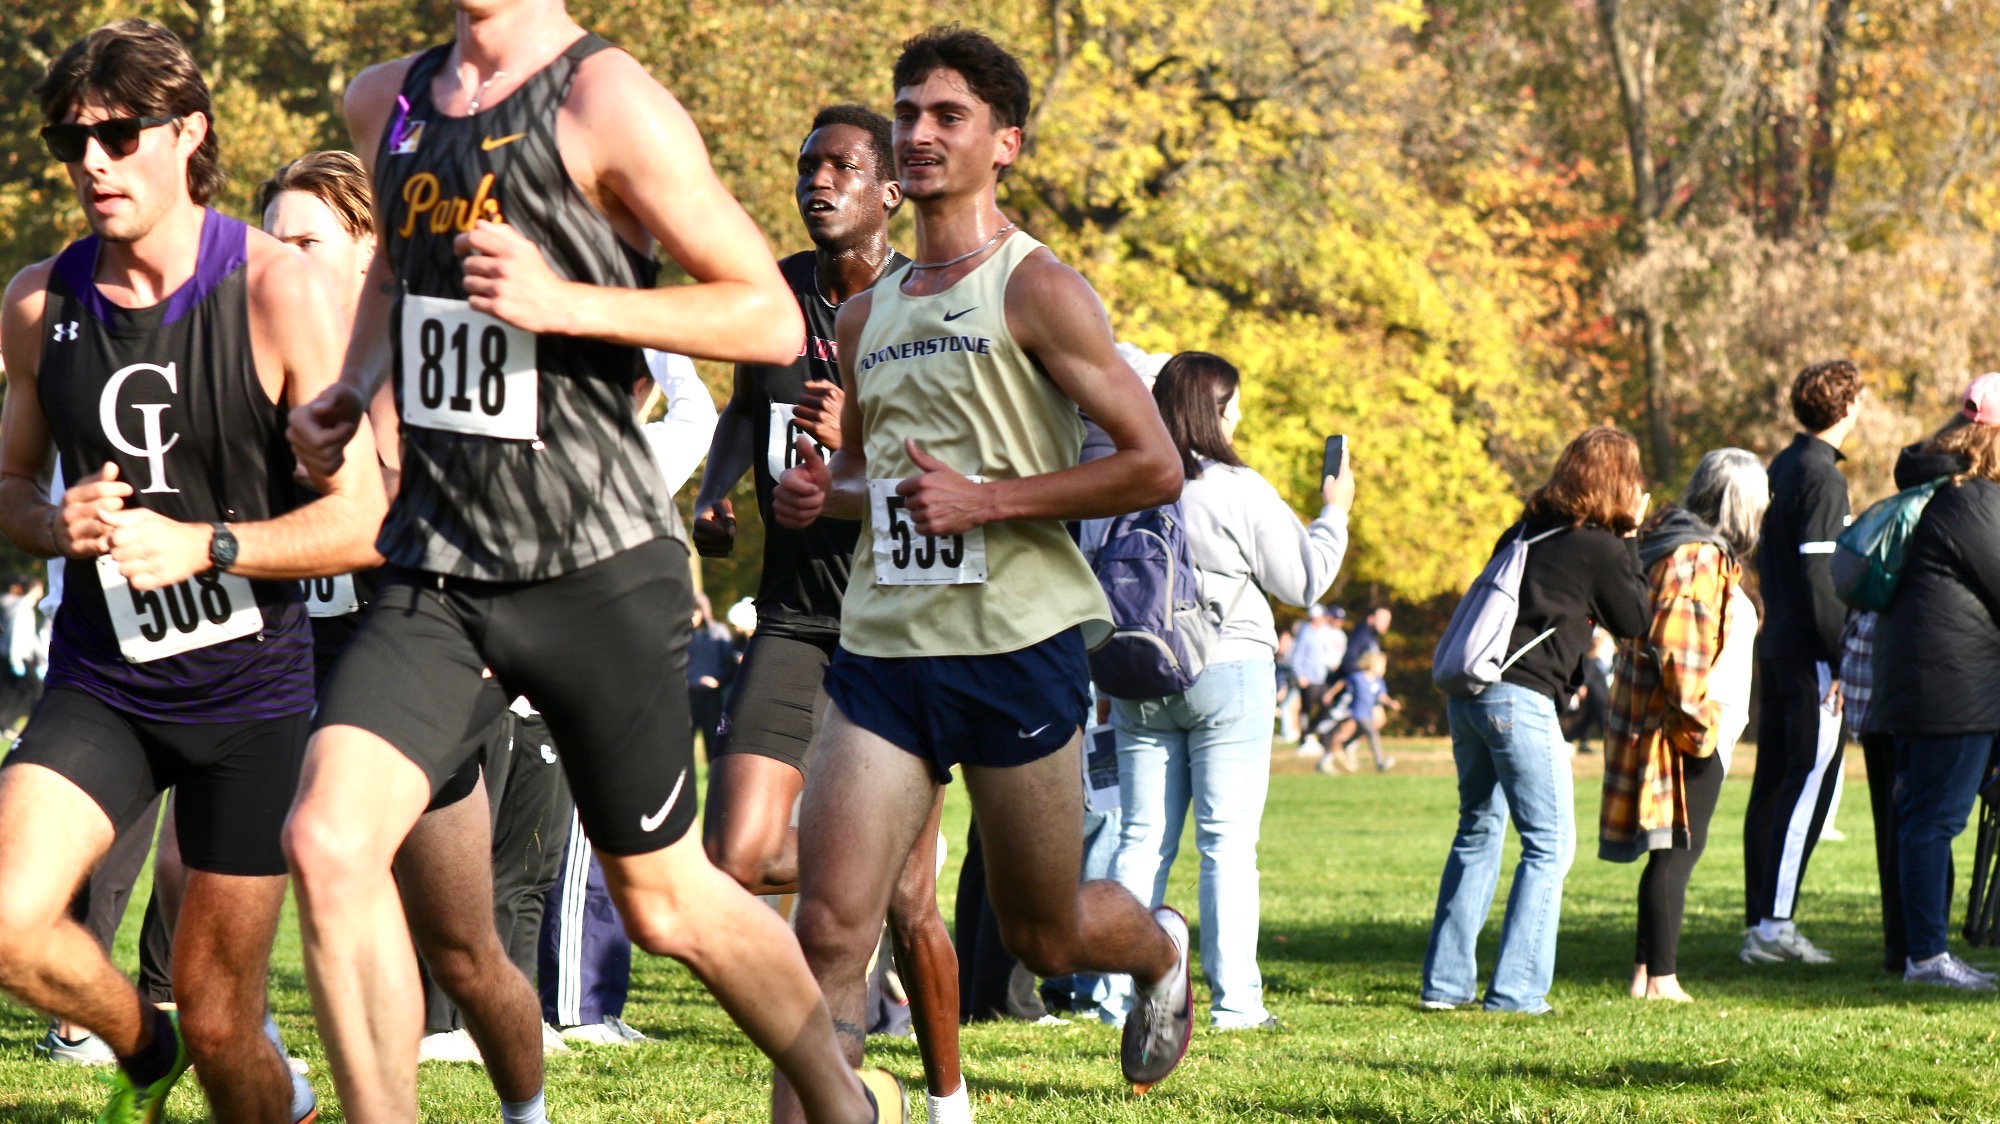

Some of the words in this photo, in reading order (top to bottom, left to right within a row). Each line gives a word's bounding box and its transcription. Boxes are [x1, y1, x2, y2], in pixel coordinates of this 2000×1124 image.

[400, 172, 503, 238] Park
[420, 318, 508, 416] 818
[129, 571, 232, 642] 508
